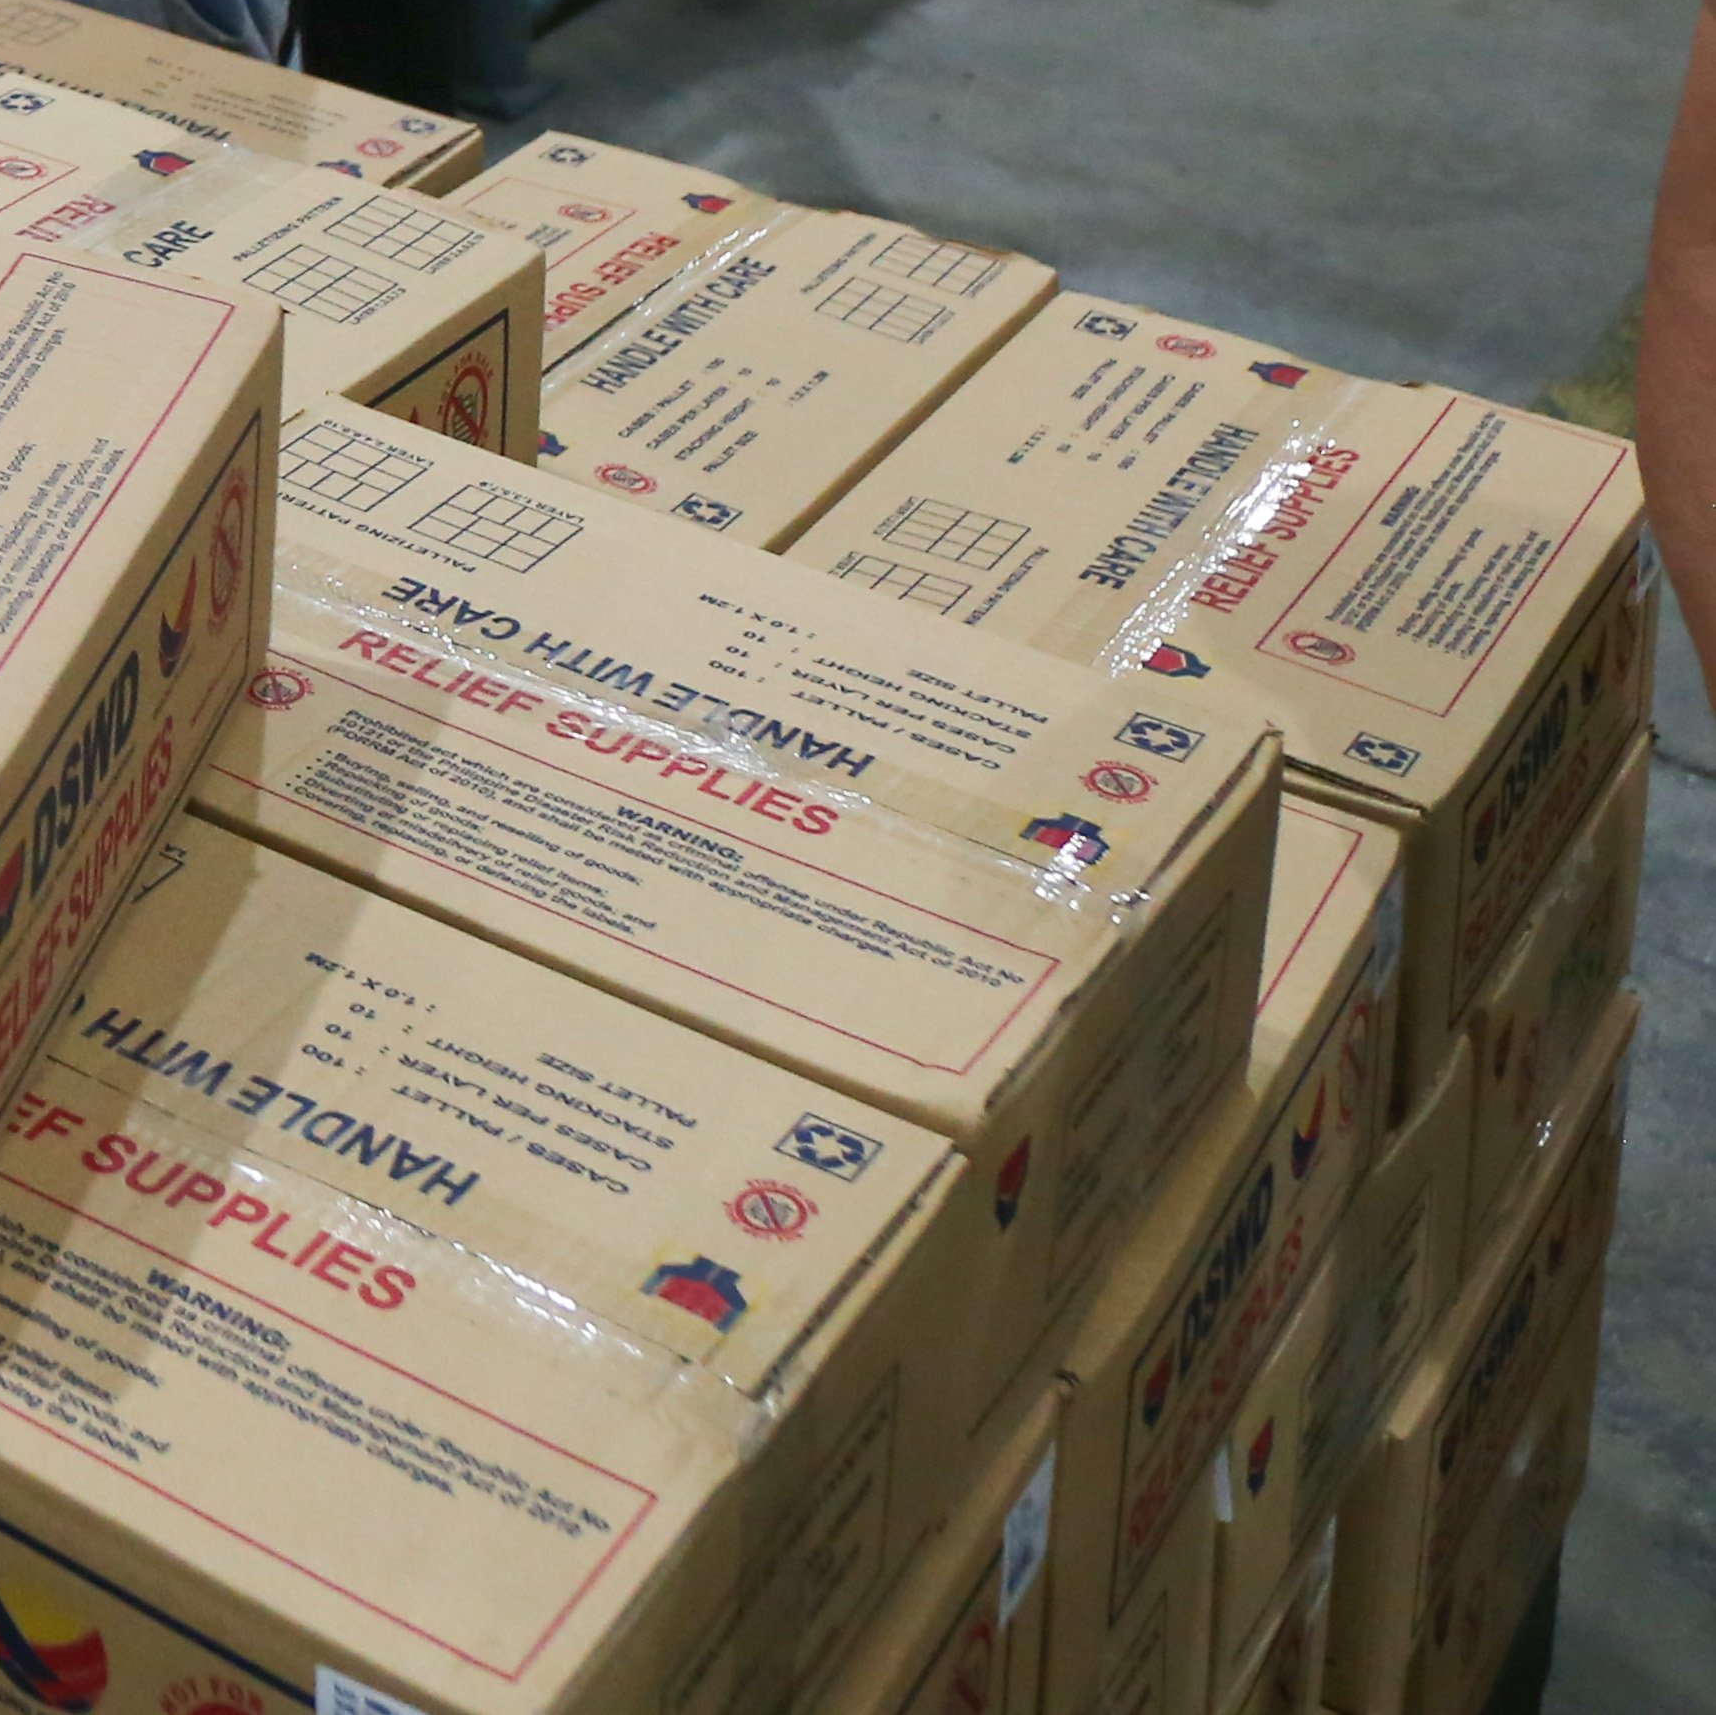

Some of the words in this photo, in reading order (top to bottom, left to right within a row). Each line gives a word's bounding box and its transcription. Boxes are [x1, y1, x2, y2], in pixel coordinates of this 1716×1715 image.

[123, 220, 214, 267] CARE
[593, 230, 681, 286] RELIEF
[579, 324, 685, 401] HANDLE
[656, 290, 731, 339] WITH
[703, 253, 780, 301] CARE
[1163, 419, 1262, 497] HANDLE
[275, 490, 350, 526] PATTER
[1126, 488, 1200, 539] WITH
[1077, 532, 1159, 592] CARE
[380, 570, 519, 646] CARE
[699, 594, 740, 613] 1.2M
[770, 621, 790, 632] 1.0
[517, 624, 649, 696] WITH
[725, 646, 748, 657] 10
[743, 631, 765, 642] 10
[708, 660, 745, 677] 100
[792, 669, 869, 700] LAYER
[812, 658, 902, 692] HEIGHT
[907, 669, 952, 690] SIZE
[336, 622, 542, 725] RELIEF
[541, 702, 844, 841] SUPPLIES
[648, 674, 878, 784] HANDLE
[791, 691, 888, 728] PALLET
[875, 700, 925, 721] PER
[909, 691, 1030, 738] STACKING
[962, 690, 1048, 723] PALLET
[910, 733, 1000, 769] CASES
[931, 720, 1015, 753] CASES
[29, 650, 138, 901] DSWD
[67, 718, 174, 948] SUPPLIES
[617, 805, 743, 862] WARNING:
[78, 1007, 236, 1094] WITH
[219, 1070, 483, 1209] HANDLE
[68, 1127, 426, 1316] SUPPLIES
[1178, 1164, 1273, 1380] DSWD
[148, 1269, 290, 1351] WARNING:
